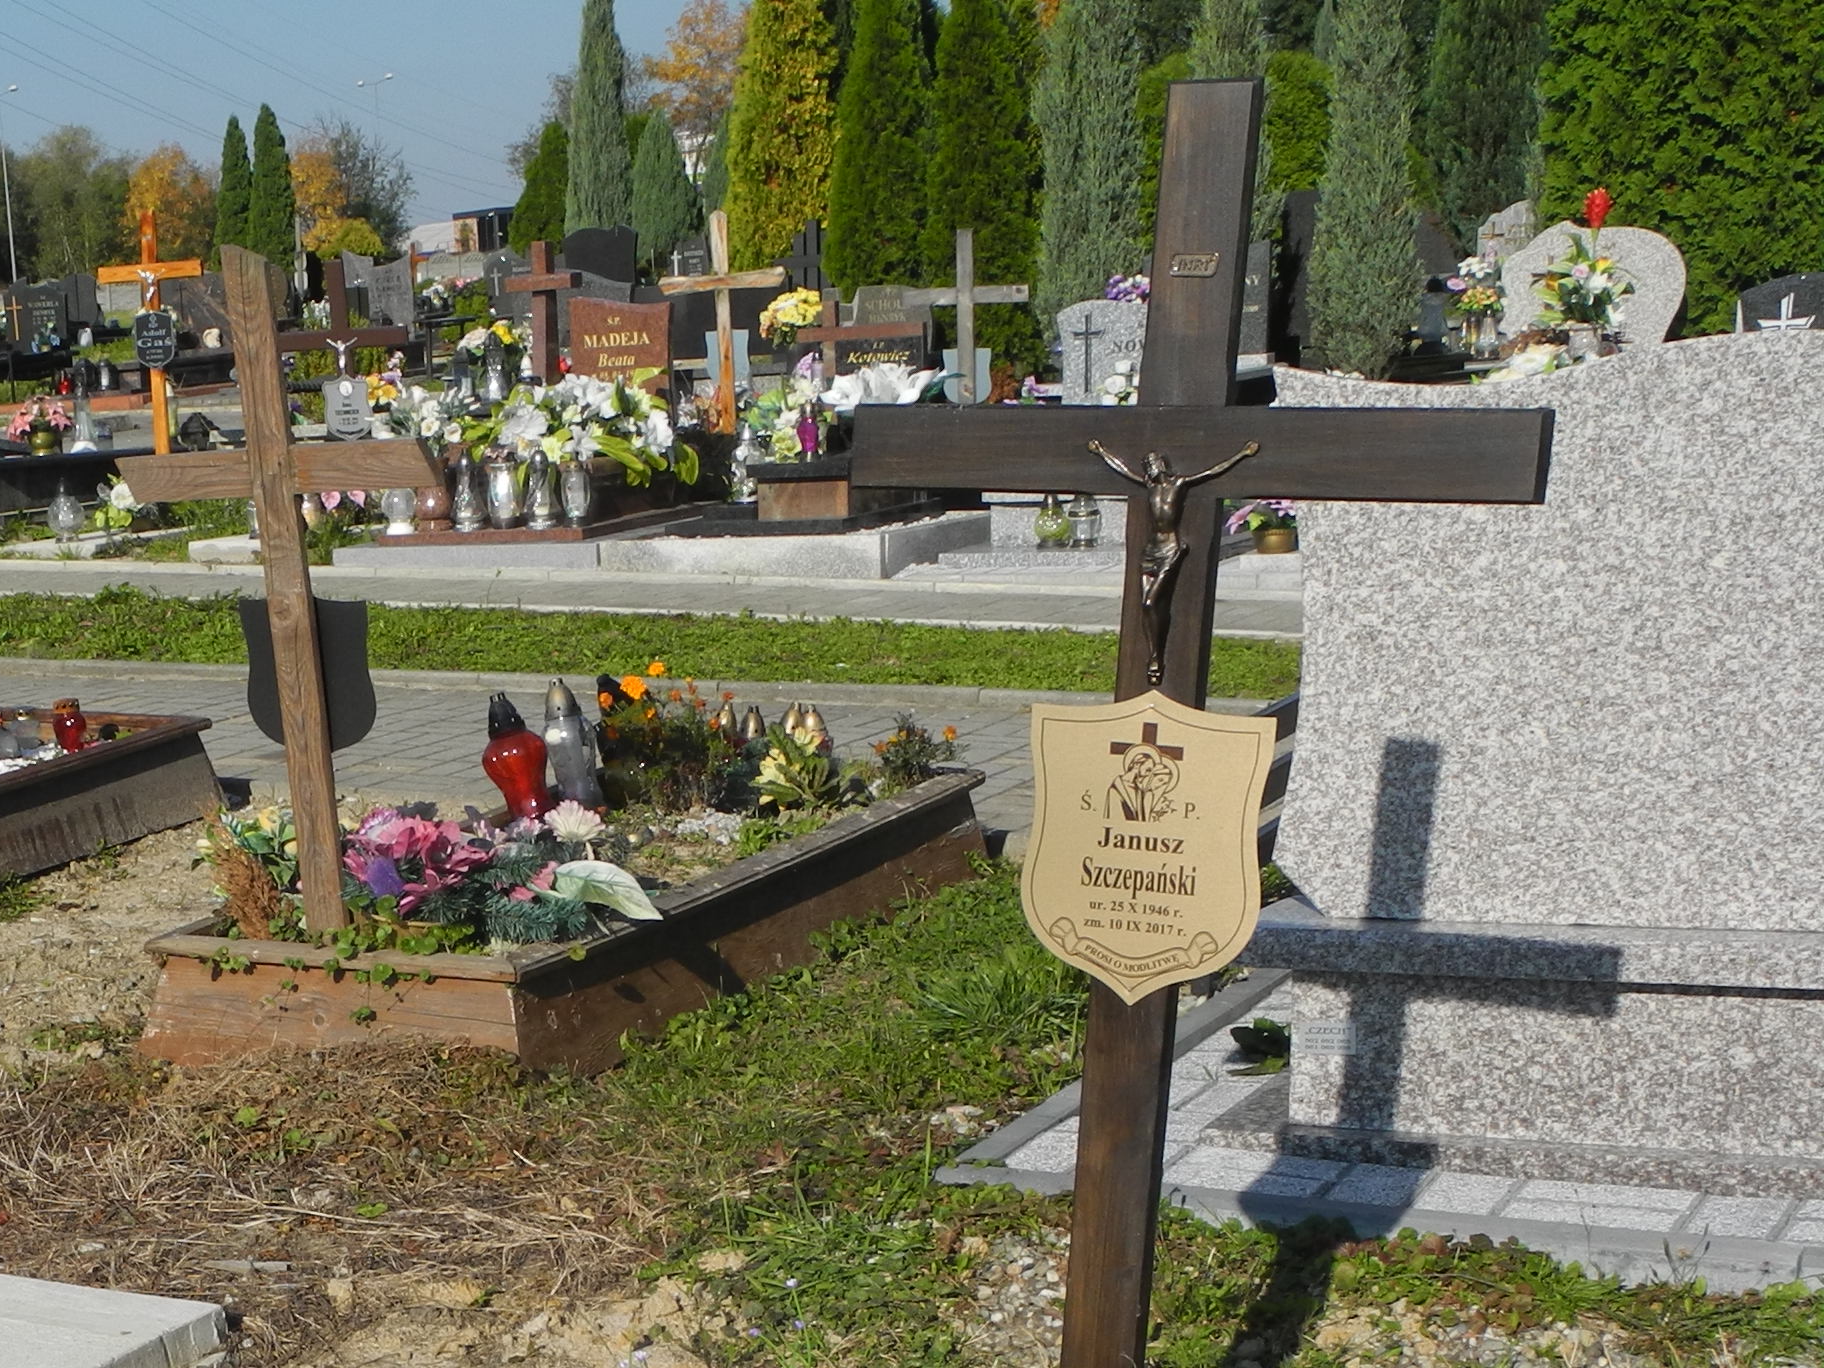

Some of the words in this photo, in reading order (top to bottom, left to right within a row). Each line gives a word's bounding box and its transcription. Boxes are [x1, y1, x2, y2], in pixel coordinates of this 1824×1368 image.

[583, 331, 651, 349] MADEJA
[598, 352, 636, 368] Beata
[847, 348, 911, 364] Kotowicz
[1097, 826, 1185, 855] Janusz
[1080, 856, 1197, 900] Szczepański
[1089, 901, 1107, 911] ur.
[1110, 900, 1125, 913] 25
[1127, 902, 1139, 914] X
[1142, 903, 1170, 918] 1946
[1173, 908, 1184, 919] r.
[1083, 918, 1106, 929] zm.
[1109, 918, 1123, 931] 10
[1126, 920, 1142, 933] IX
[1145, 922, 1174, 936] 2017
[1177, 926, 1188, 938] r.
[1084, 944, 1112, 966] PROSI
[1113, 959, 1123, 970] O
[1122, 953, 1181, 974] MODLITWĘ
